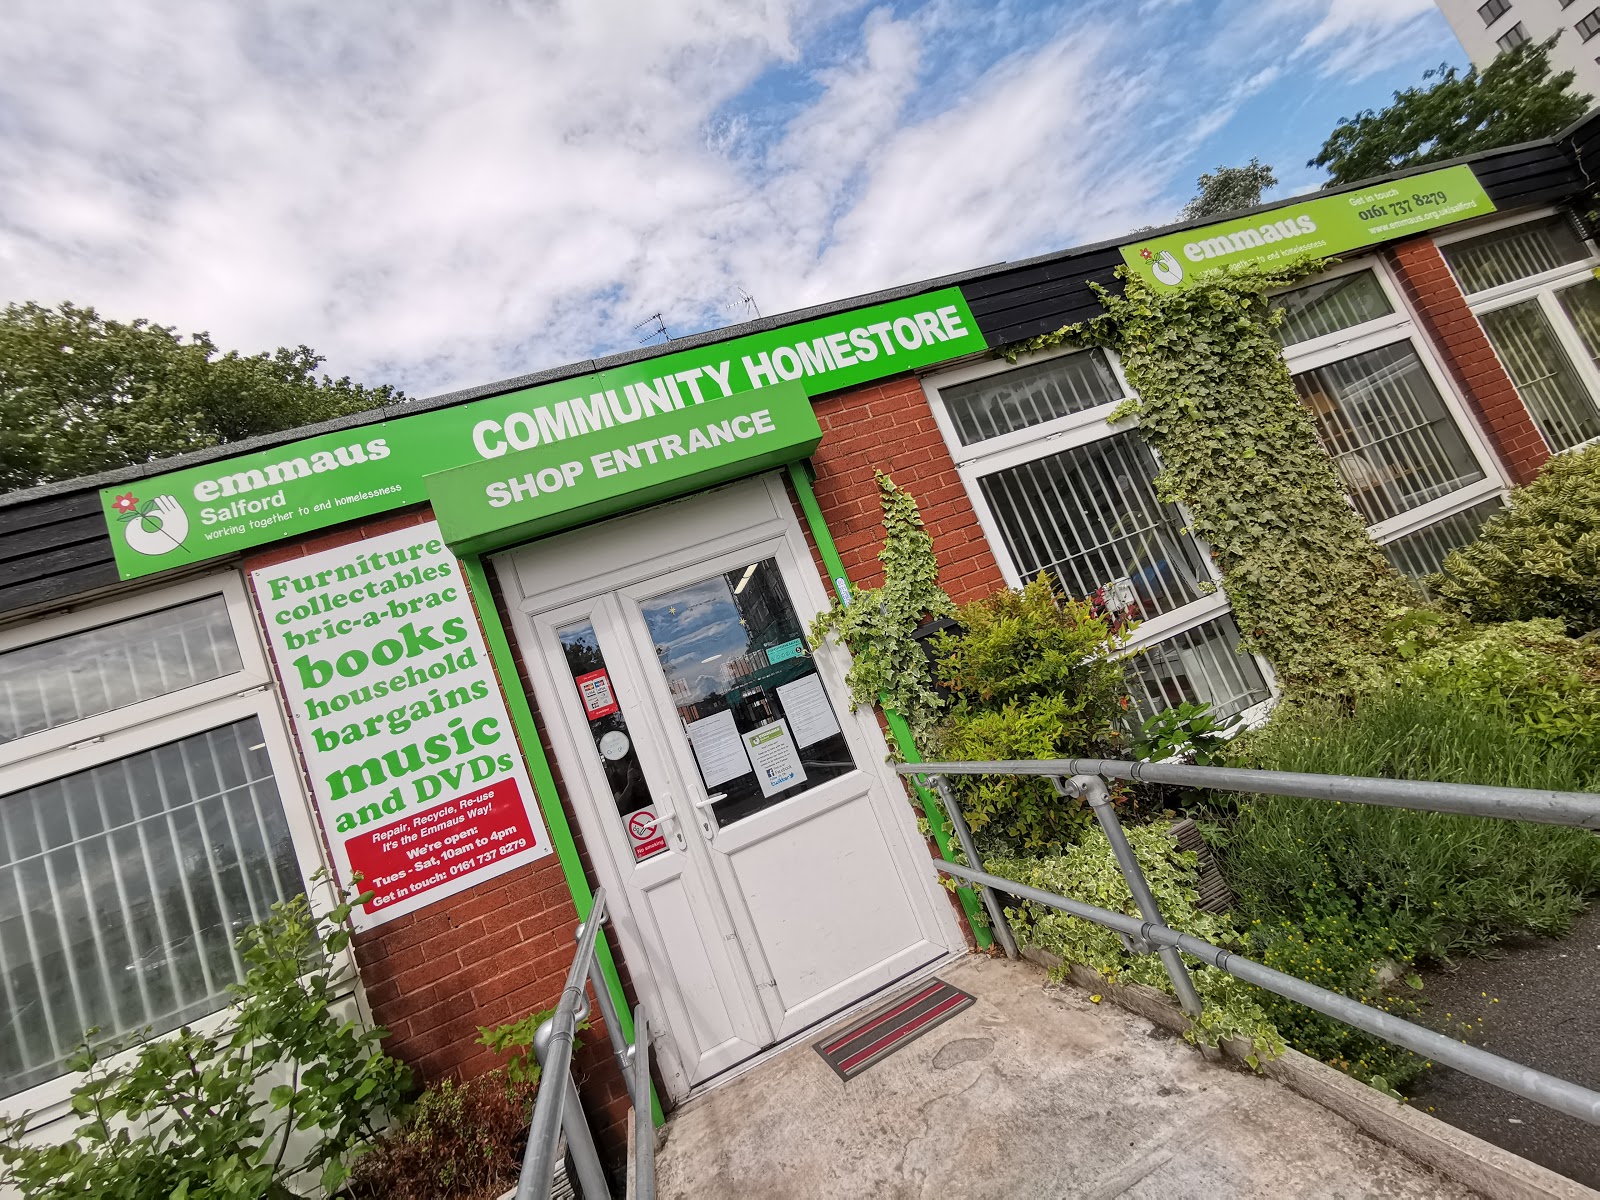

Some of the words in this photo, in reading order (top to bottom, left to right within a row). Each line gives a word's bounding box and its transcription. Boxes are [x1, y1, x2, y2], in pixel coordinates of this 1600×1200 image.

[1349, 196, 1365, 207] Get
[1366, 194, 1375, 203] in
[1374, 188, 1399, 201] touch
[1358, 204, 1388, 220] 0161
[1388, 199, 1413, 216] 737
[1411, 191, 1448, 207] 8279
[1368, 200, 1477, 235] www.emmaus.org.uk/salford
[1183, 215, 1317, 262] emmaus
[1267, 250, 1280, 261] end
[1280, 239, 1327, 256] homelessness
[472, 360, 733, 459] COMMUNITY
[741, 305, 969, 389] HOMESTORE
[193, 439, 391, 502] emmaus
[486, 461, 584, 508] SHOP
[590, 409, 776, 479] ENTRANCE
[200, 490, 287, 525] Salford
[204, 523, 246, 541] working
[249, 510, 294, 531] together
[298, 506, 310, 516] to
[313, 500, 332, 512] end
[334, 484, 402, 507] homelessness
[267, 539, 443, 601] Furniture
[275, 562, 451, 625] collectables
[282, 587, 458, 650] bric-a-brac
[292, 617, 468, 690] books
[304, 646, 478, 721] household
[311, 679, 489, 753] bargains
[325, 717, 501, 801] music
[335, 787, 407, 833] and
[412, 753, 514, 804] DVDs
[372, 823, 411, 844] Repair,
[413, 805, 458, 828] Recycle,
[459, 790, 495, 810] Re-use
[373, 870, 407, 888] Tues
[414, 856, 440, 873] Sat,
[440, 843, 474, 862] 10am
[475, 836, 488, 847] to
[490, 824, 517, 842] 4pm
[382, 839, 399, 853] It's
[401, 833, 418, 846] the
[420, 814, 465, 837] Emmaus
[467, 802, 493, 818] Way!
[406, 841, 442, 860] We're
[444, 825, 479, 846] open:
[644, 840, 665, 851] smoking
[373, 893, 395, 908] Get
[397, 887, 409, 897] in
[410, 870, 447, 893] touch:
[450, 858, 475, 876] 0161
[477, 850, 497, 866] 737
[499, 838, 526, 856] 8279
